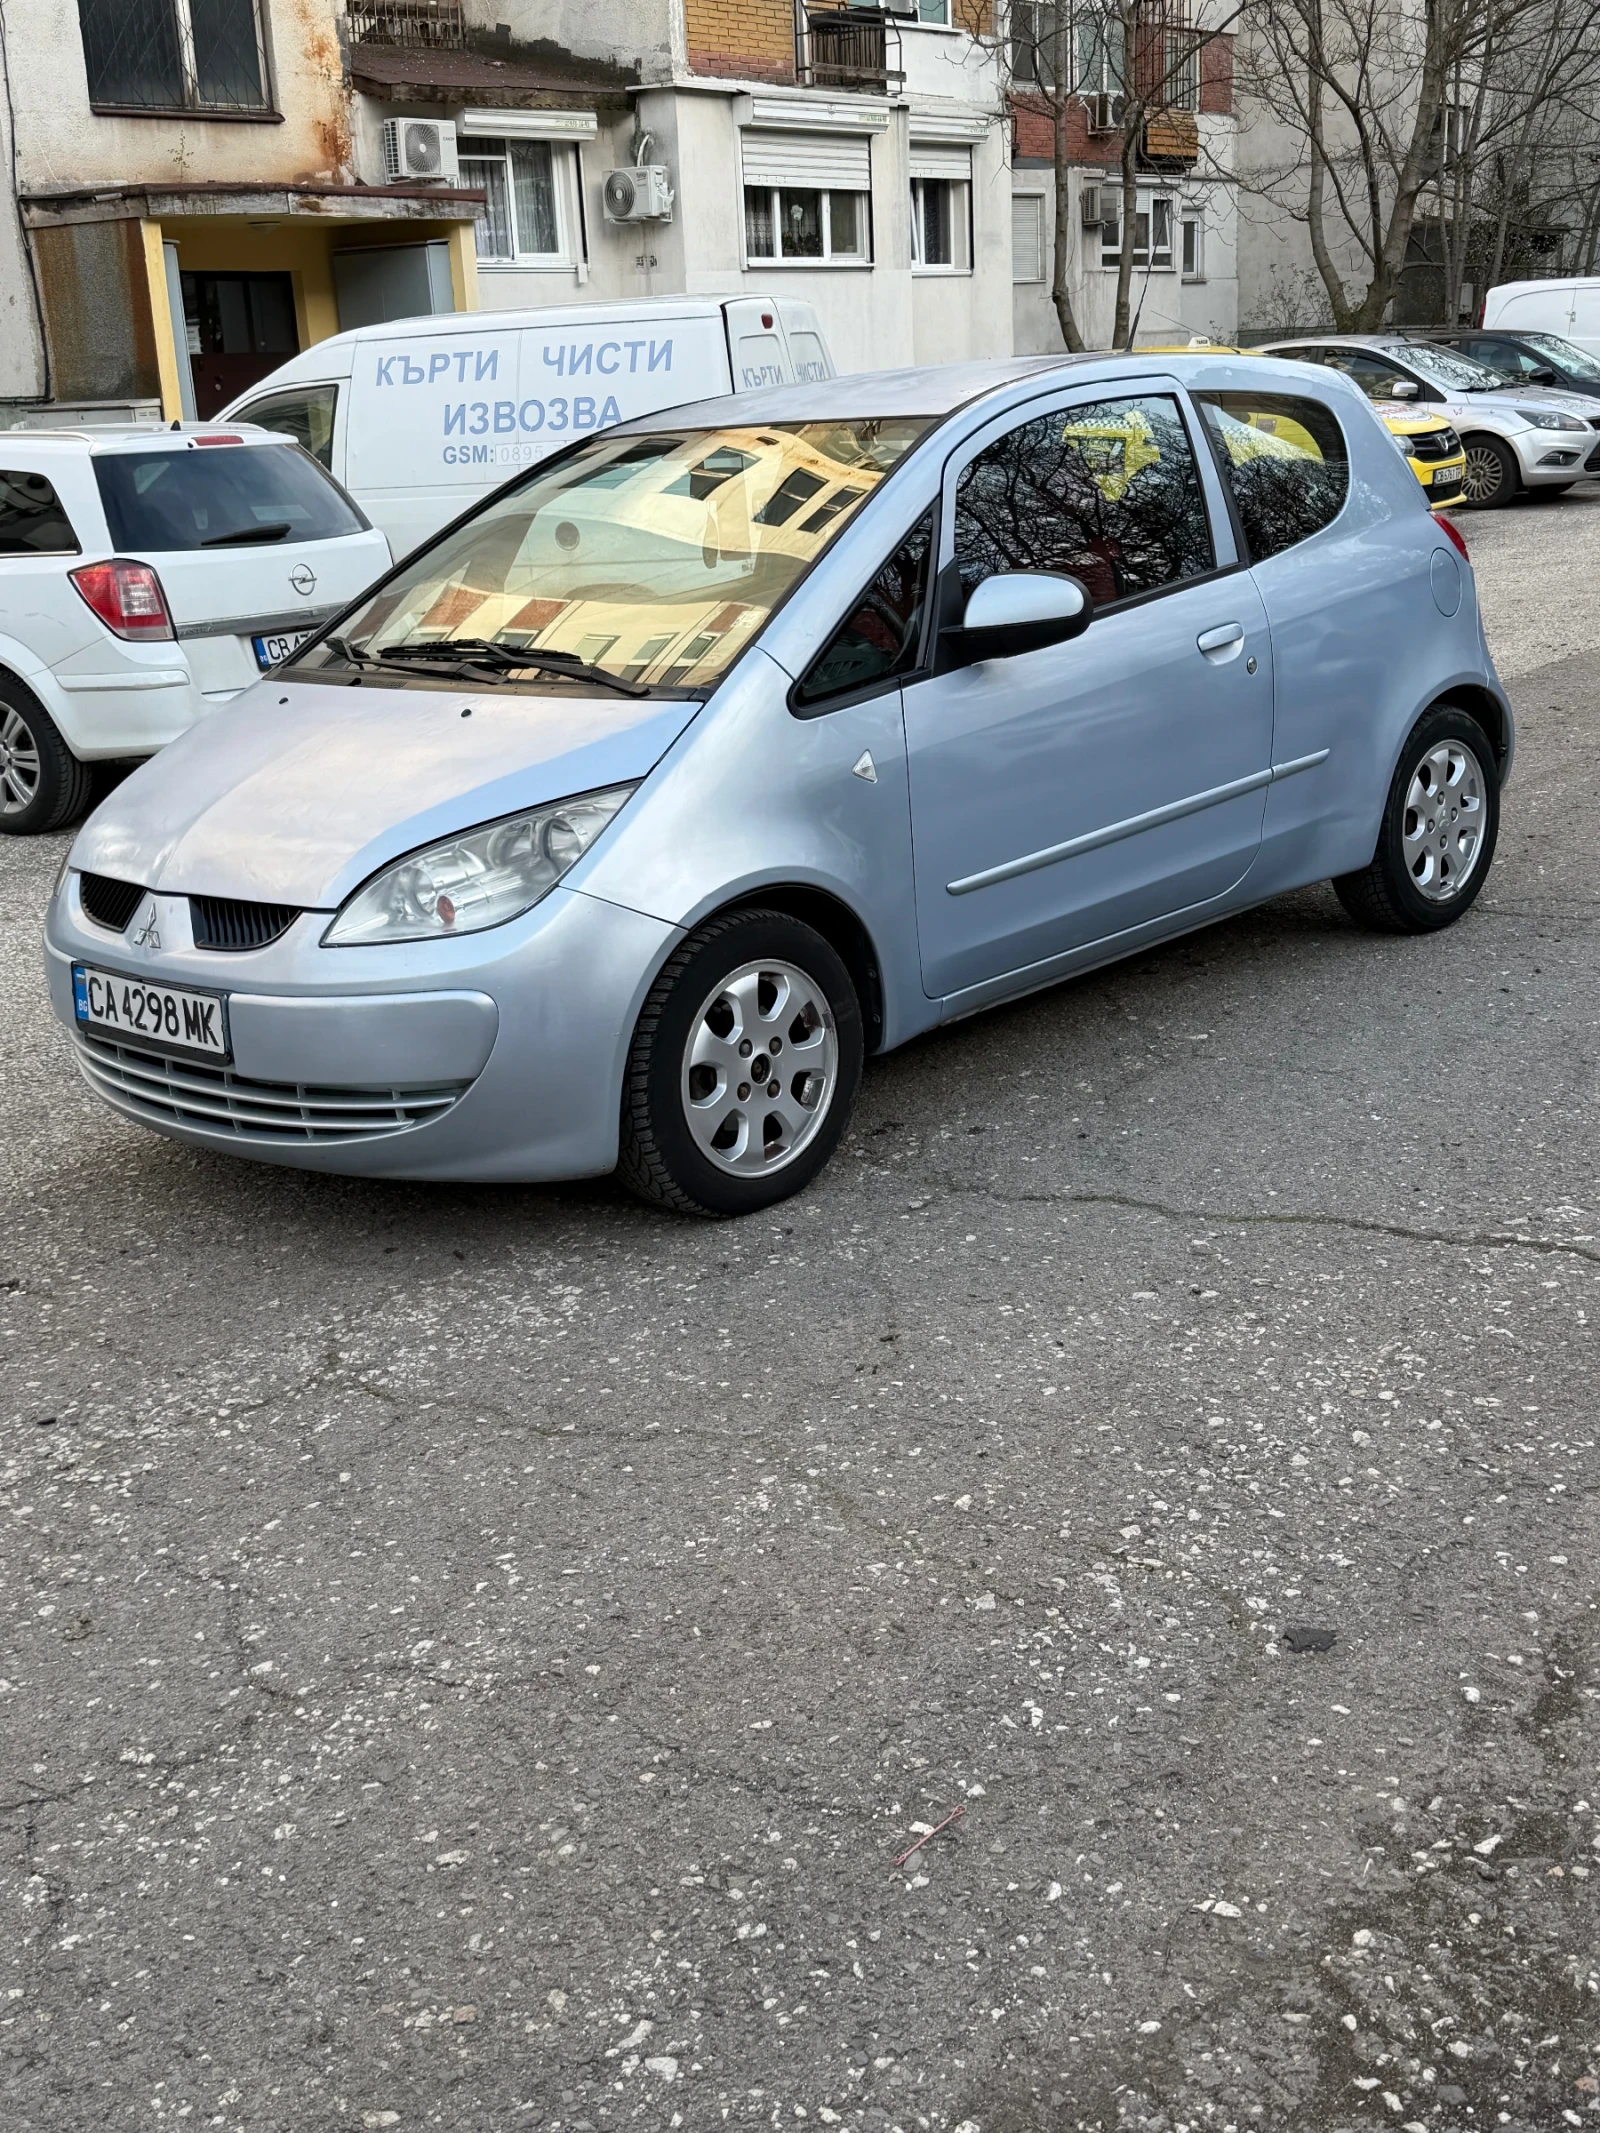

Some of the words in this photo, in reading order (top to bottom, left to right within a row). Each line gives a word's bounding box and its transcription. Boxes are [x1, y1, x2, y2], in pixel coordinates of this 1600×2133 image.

[376, 350, 500, 387] КЪРТИ
[543, 339, 674, 377] ЧИСТИ
[795, 361, 826, 383] ЧИСТИ
[741, 364, 784, 388] КЪРТИ
[443, 396, 623, 436] ИЗВОЗВА
[442, 444, 495, 465] GSM:
[78, 1000, 88, 1012] BG
[88, 976, 119, 1023] CA
[122, 985, 180, 1037] 4298
[182, 998, 220, 1047] MK
